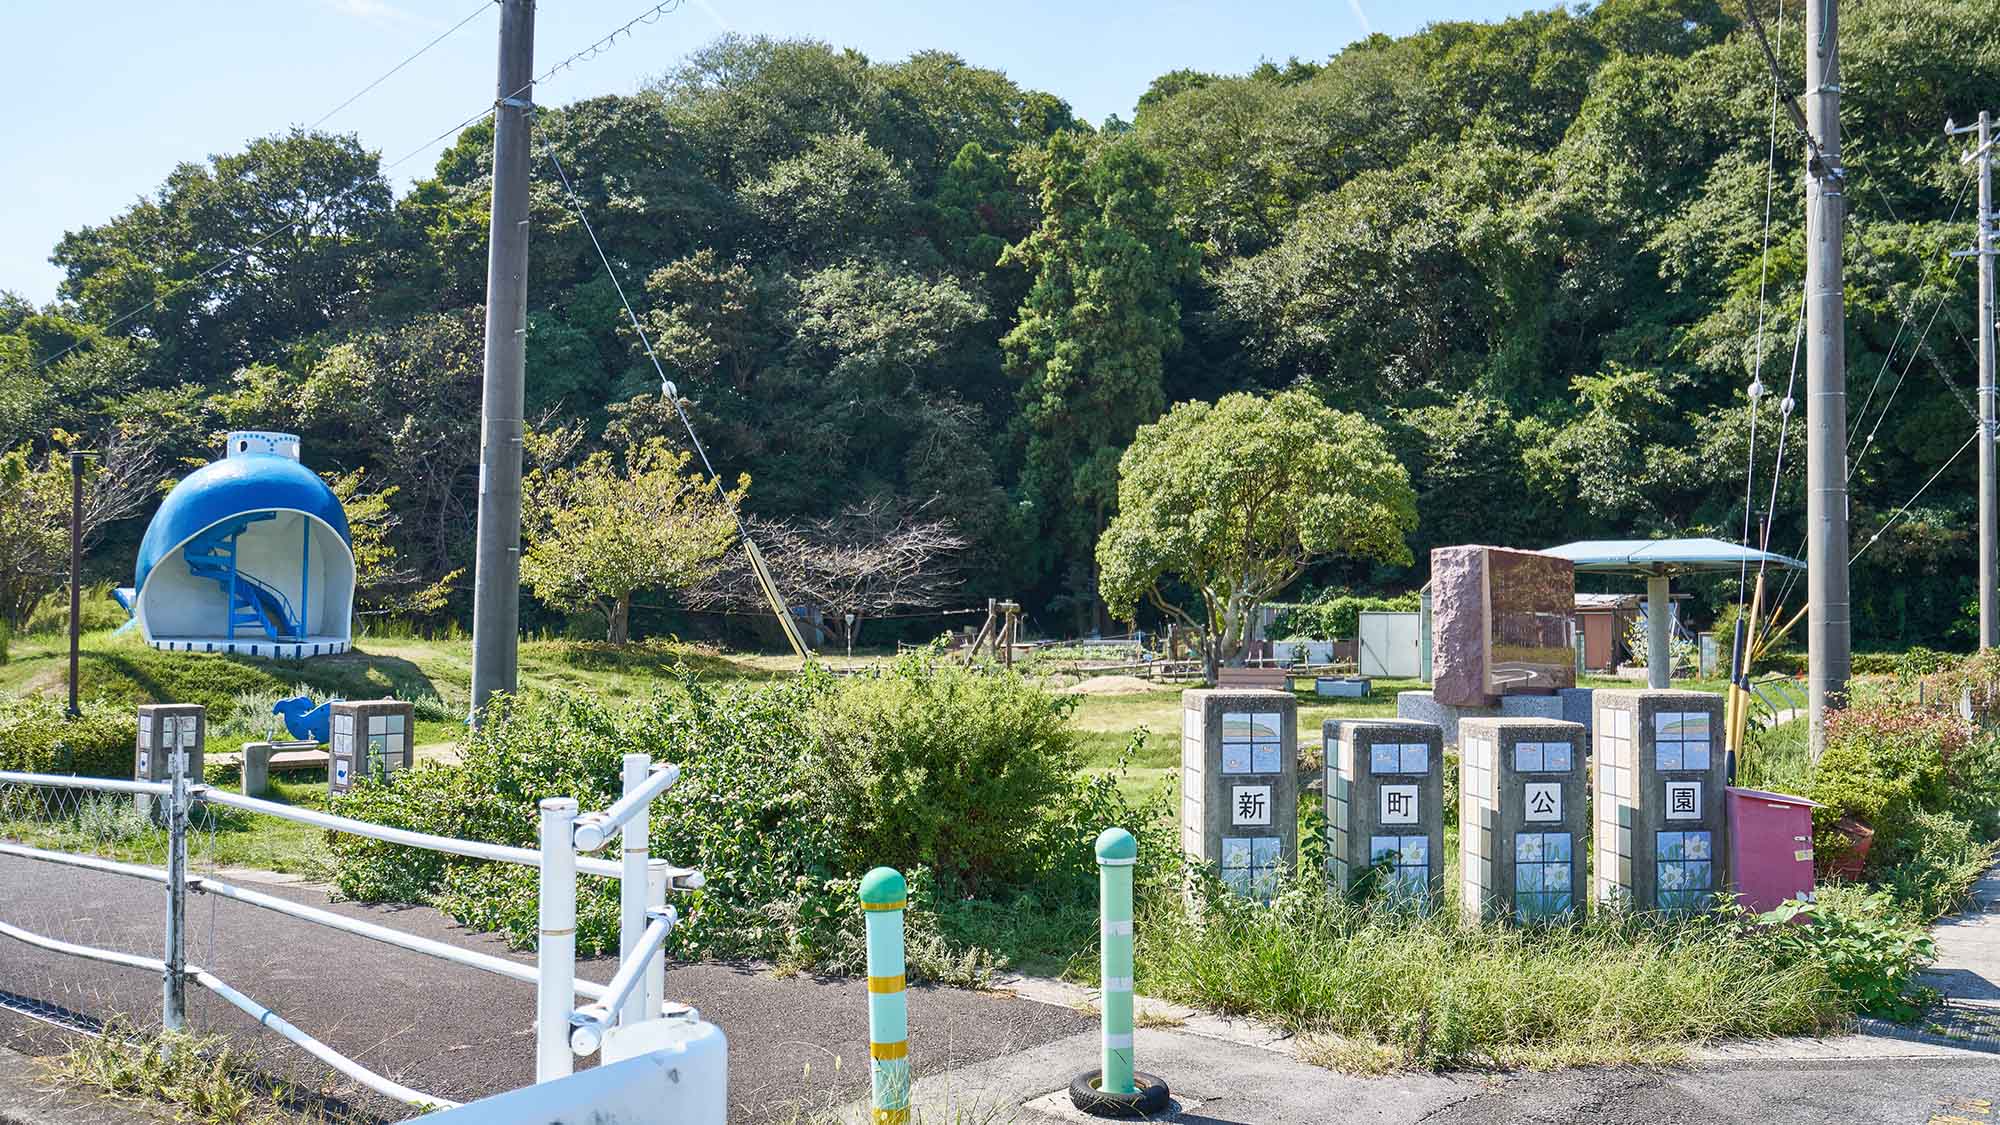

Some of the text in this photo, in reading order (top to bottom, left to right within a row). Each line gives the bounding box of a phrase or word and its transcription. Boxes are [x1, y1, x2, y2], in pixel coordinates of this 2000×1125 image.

[1239, 788, 1696, 819] 新 町 公 園
